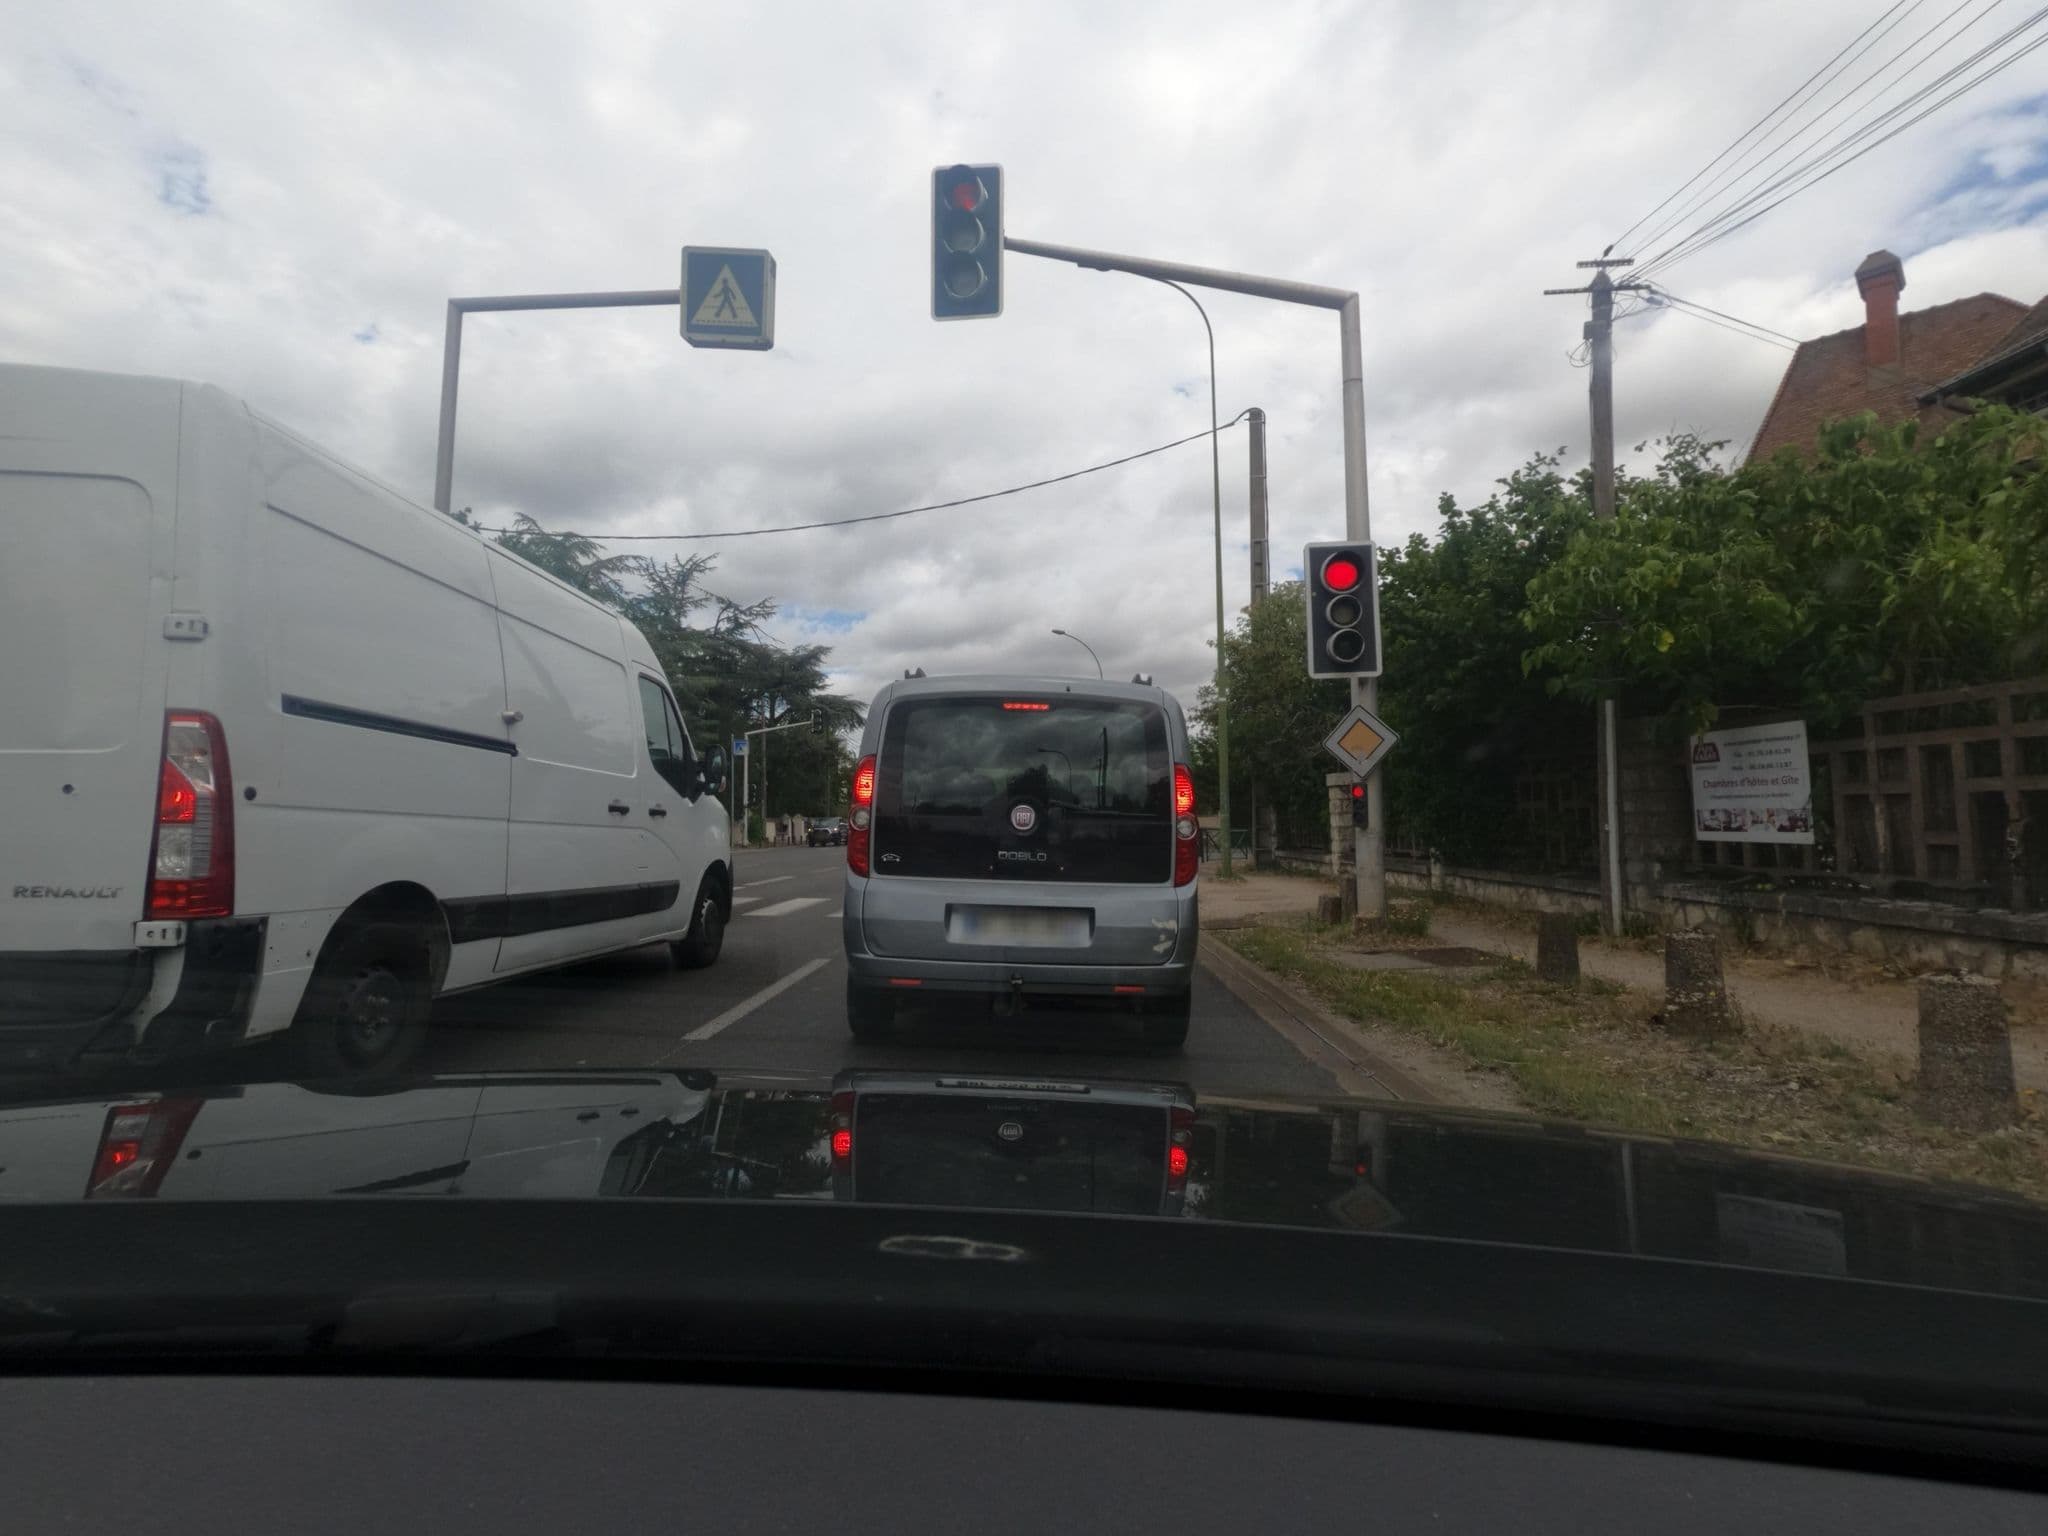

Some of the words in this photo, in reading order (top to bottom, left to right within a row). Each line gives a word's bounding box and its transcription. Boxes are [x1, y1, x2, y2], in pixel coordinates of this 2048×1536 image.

[1781, 774, 1800, 785] Gîte
[1016, 812, 1032, 825] FIAT
[998, 850, 1047, 862] DOBLO
[13, 885, 125, 899] RENAULT
